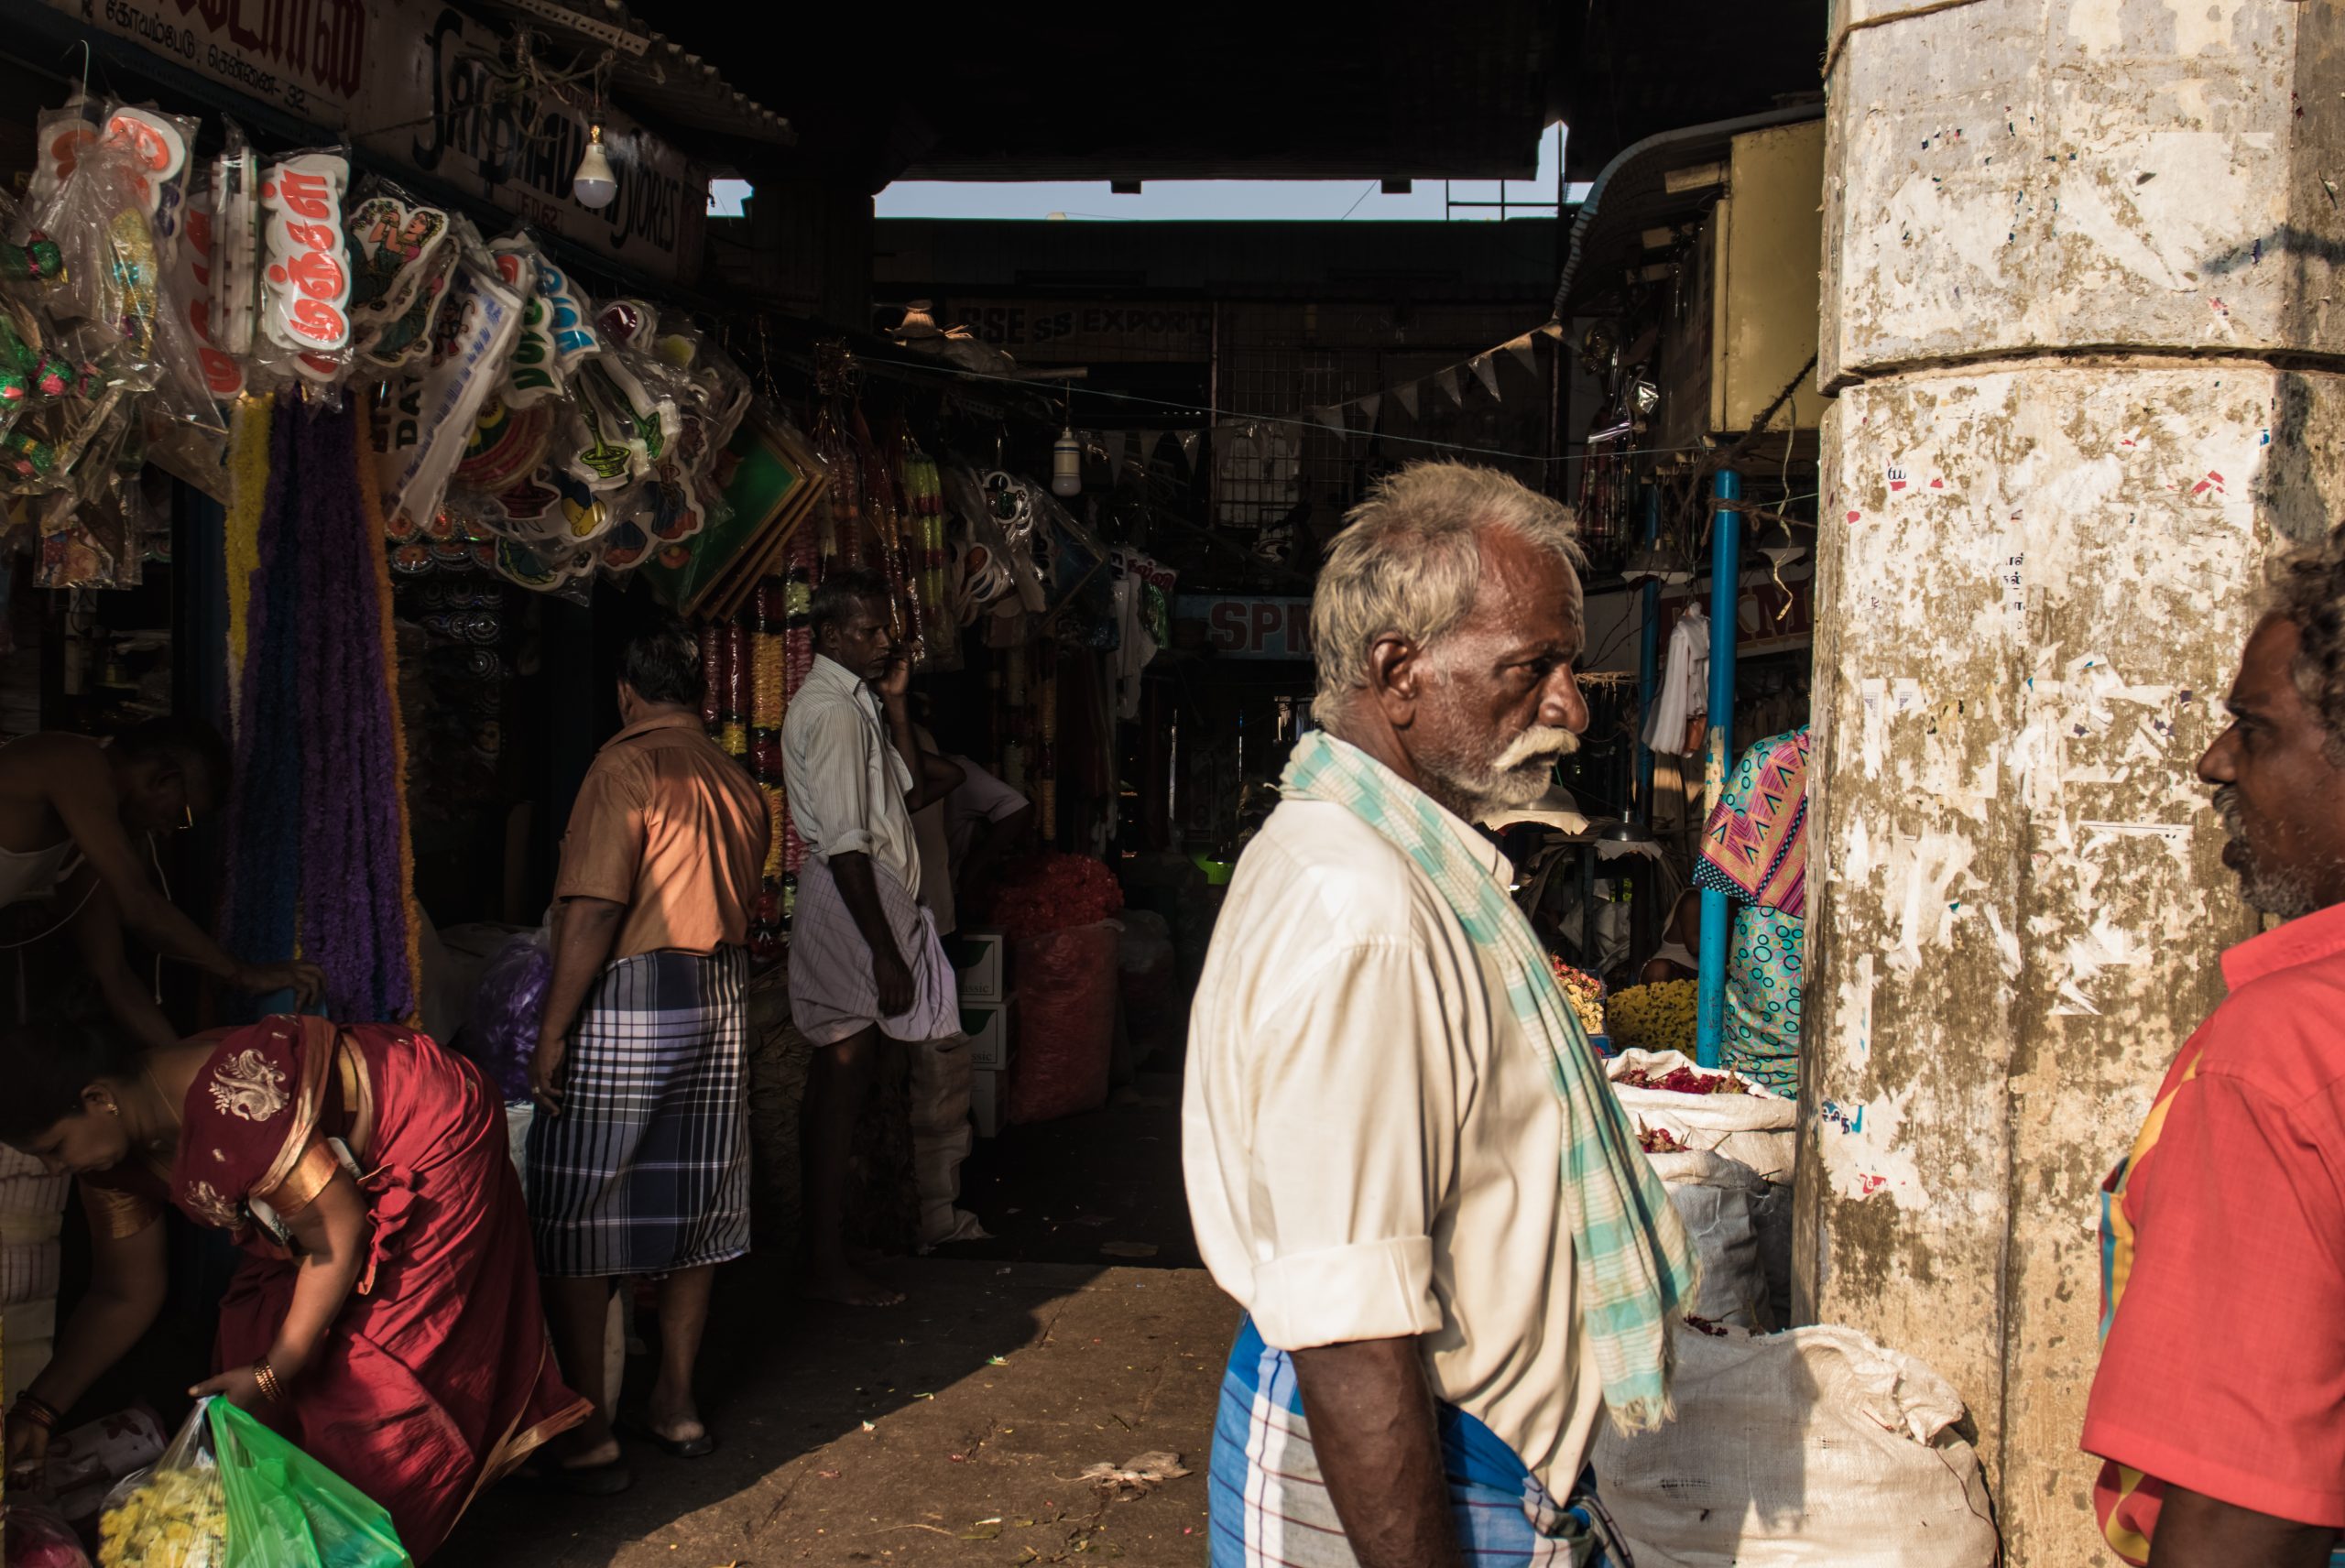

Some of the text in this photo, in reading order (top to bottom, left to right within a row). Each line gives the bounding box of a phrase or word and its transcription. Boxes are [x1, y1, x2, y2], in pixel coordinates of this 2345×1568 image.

[412, 8, 485, 171] SRI
[261, 169, 344, 342] மஞ்சள்
[971, 1051, 992, 1062] ssic
